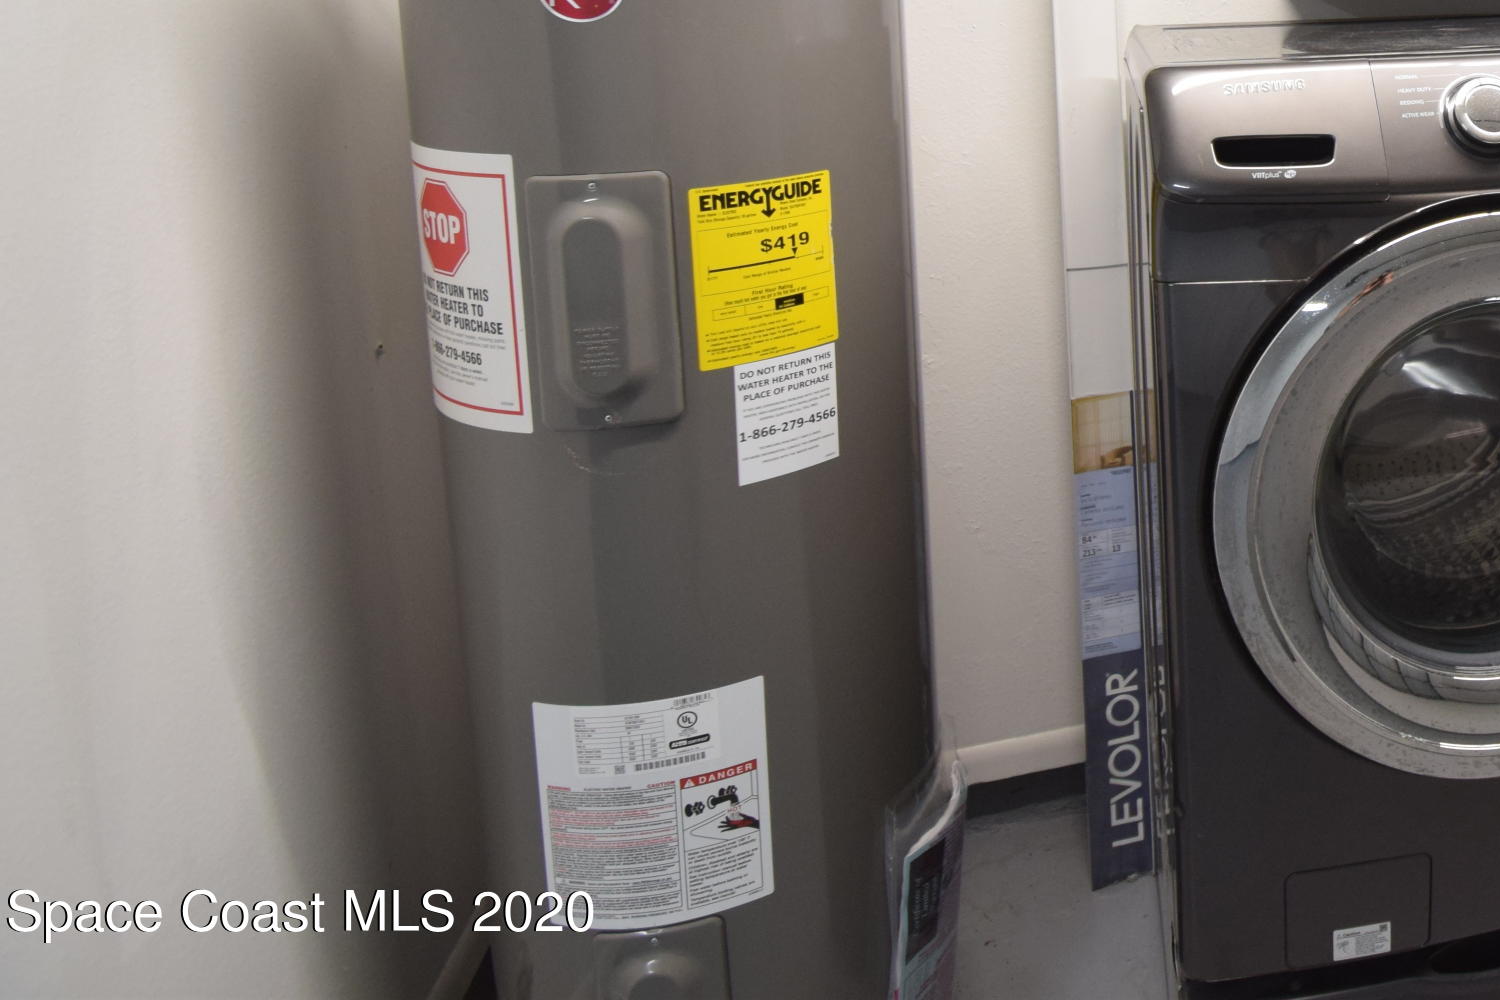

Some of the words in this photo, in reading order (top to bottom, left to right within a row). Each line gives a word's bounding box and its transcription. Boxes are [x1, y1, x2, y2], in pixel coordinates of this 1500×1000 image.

[1223, 79, 1305, 97] SAMSUNG
[699, 178, 822, 215] ENERGYGUIDE
[423, 208, 460, 244] STOP
[760, 231, 810, 253] $419
[436, 280, 464, 298] RETURN
[467, 287, 489, 302] THIS
[440, 297, 469, 315] HEATER
[471, 303, 484, 317] TO
[443, 312, 452, 326] OF
[454, 315, 504, 335] PURCHASE
[738, 379, 773, 391] WATER
[772, 371, 804, 384] HEATER
[806, 367, 817, 376] TO
[819, 361, 833, 370] THE
[740, 371, 754, 380] DO
[757, 366, 776, 377] NOT
[778, 357, 812, 371] RETURN
[814, 351, 831, 362] THIS
[743, 391, 772, 402] PLACE
[773, 386, 786, 396] OF
[787, 374, 831, 391] PURCHASE
[740, 407, 836, 443] 1-866-279-4566
[1105, 668, 1145, 848] LEVOLOR
[698, 762, 753, 785] DANGER
